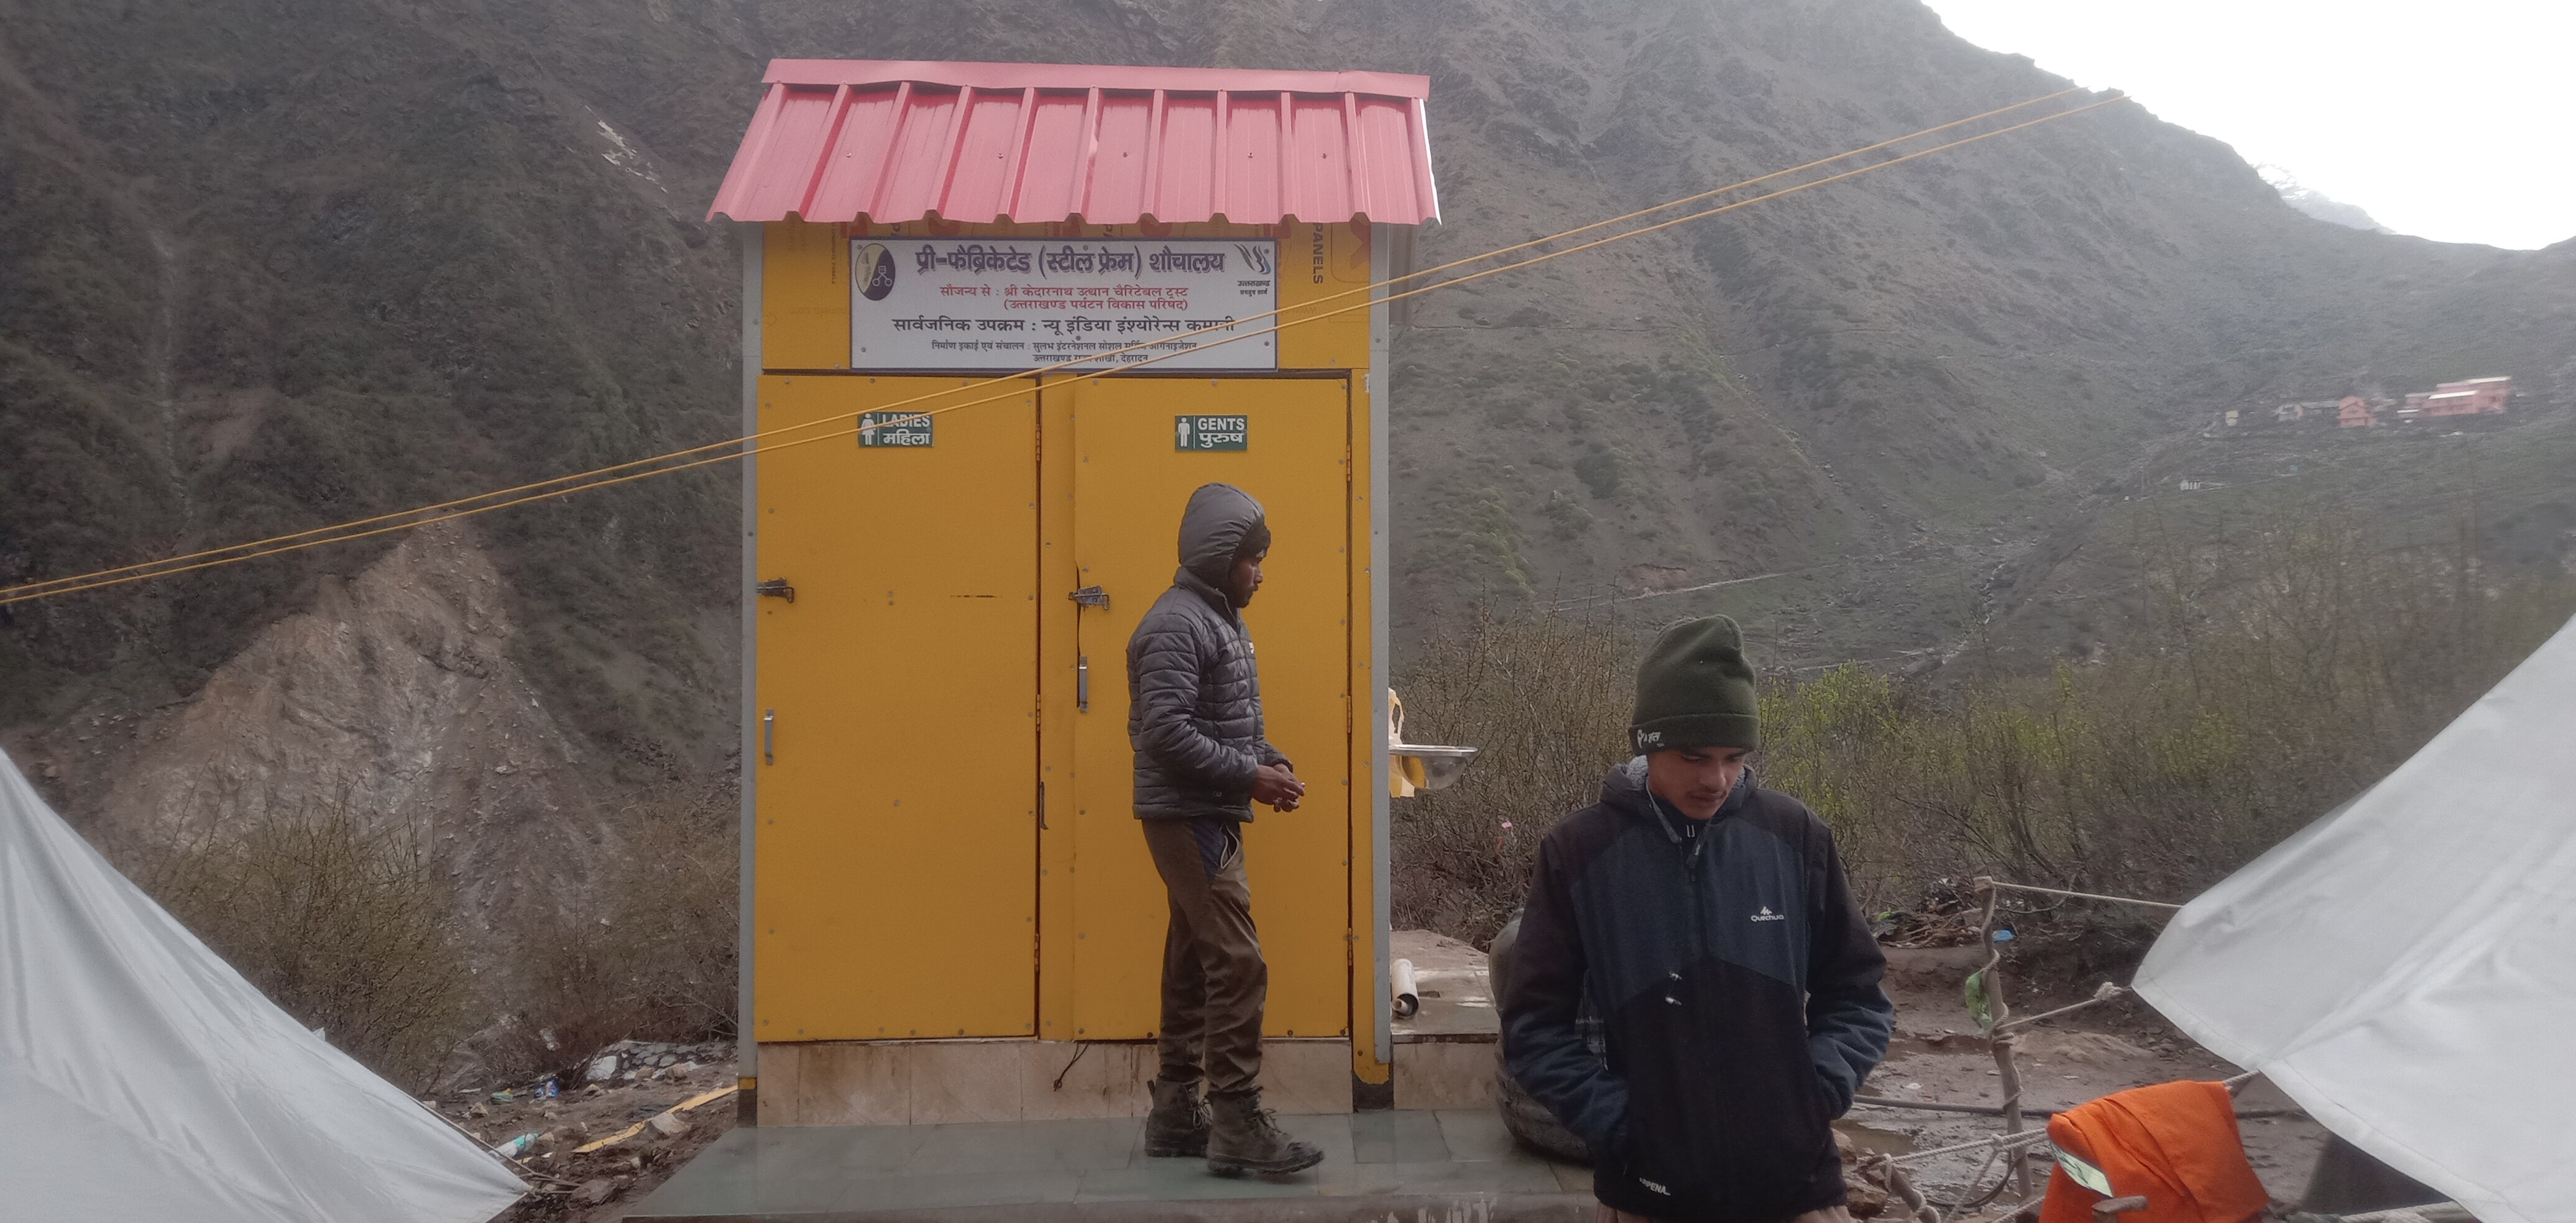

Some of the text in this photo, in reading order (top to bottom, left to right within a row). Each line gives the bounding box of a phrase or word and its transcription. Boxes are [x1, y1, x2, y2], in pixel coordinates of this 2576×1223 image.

[1098, 245, 1142, 280] फ्रेम)
[1149, 245, 1225, 273] शौचालय
[940, 283, 977, 296] सौजन्य
[981, 284, 991, 296] से
[1004, 284, 1018, 296] श्री
[1021, 284, 1074, 297] केदारनाथ
[1077, 286, 1110, 297] उत्थान
[1113, 284, 1162, 297] चैरिटेबल
[1165, 288, 1189, 300] ट्रस्ट
[1070, 297, 1103, 309] पर्यटन
[1108, 298, 1145, 309] विकास
[892, 315, 972, 331] सार्वजनिक
[975, 319, 1026, 331] उपक्रम
[1041, 319, 1064, 336] न्यू
[1065, 316, 1112, 334] इंडिया
[932, 340, 957, 350] निर्माण
[995, 341, 1025, 350] संचालन
[1033, 342, 1054, 352] सुलभ
[1056, 340, 1096, 351] इंटरनेशनल
[1098, 340, 1121, 350] सोशल
[882, 414, 931, 427] LADIES
[1198, 418, 1244, 431] GENTS
[883, 429, 931, 446] महिला
[1198, 433, 1244, 448] पुरुष
